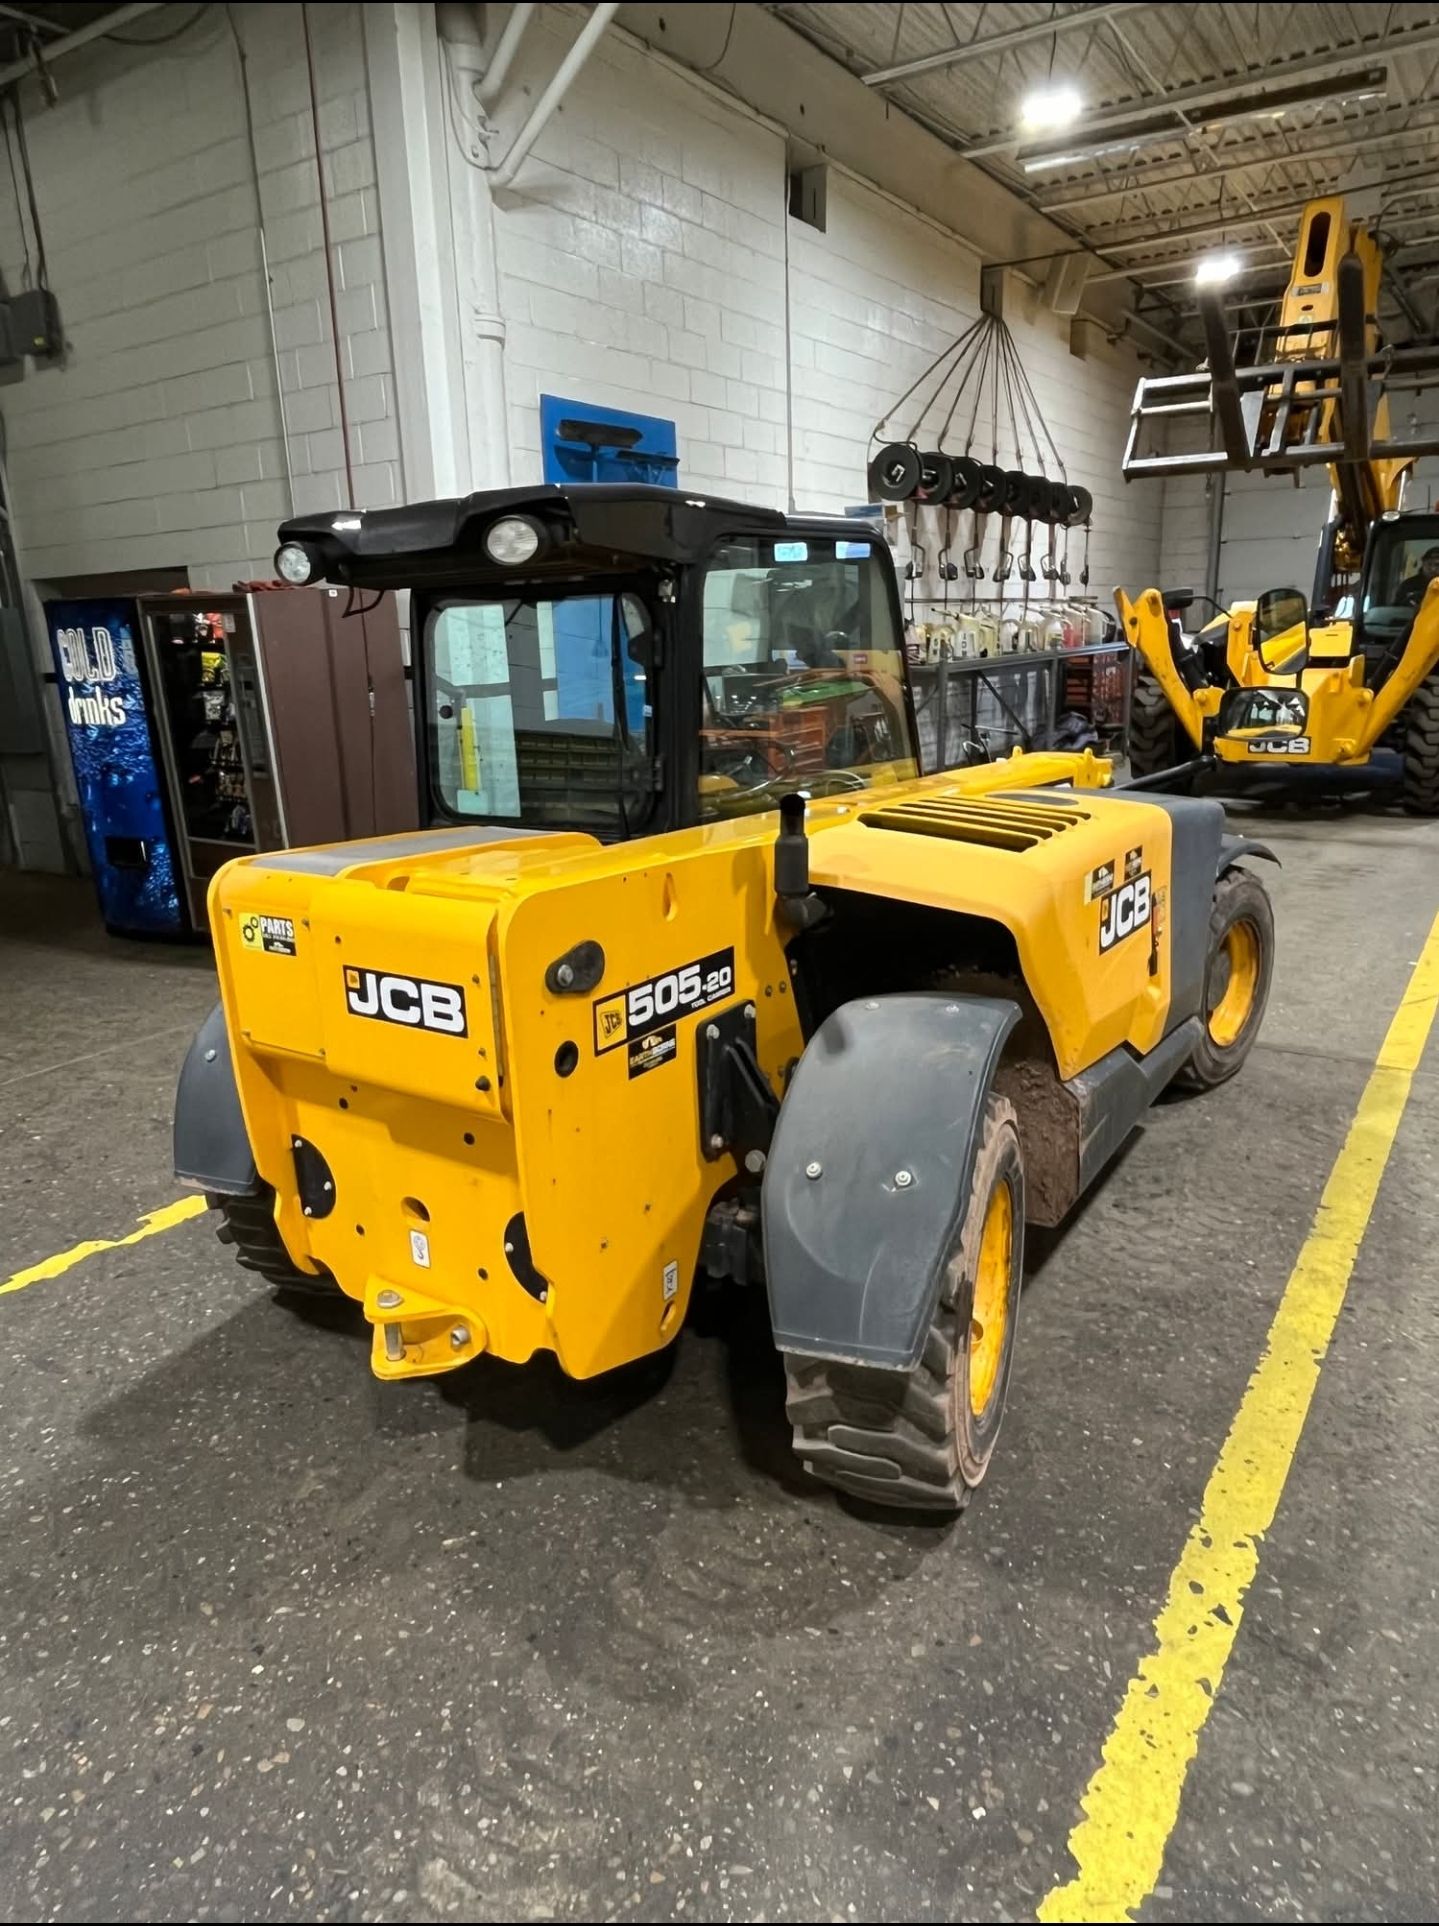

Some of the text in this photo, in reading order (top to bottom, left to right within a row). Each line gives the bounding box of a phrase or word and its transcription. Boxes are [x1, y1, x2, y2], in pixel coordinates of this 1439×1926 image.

[57, 627, 117, 682] COLD
[68, 686, 127, 726] drinks
[1249, 738, 1310, 753] JCB
[260, 916, 294, 938] PARTS
[1100, 876, 1150, 947] JCB
[348, 972, 465, 1033] JCB
